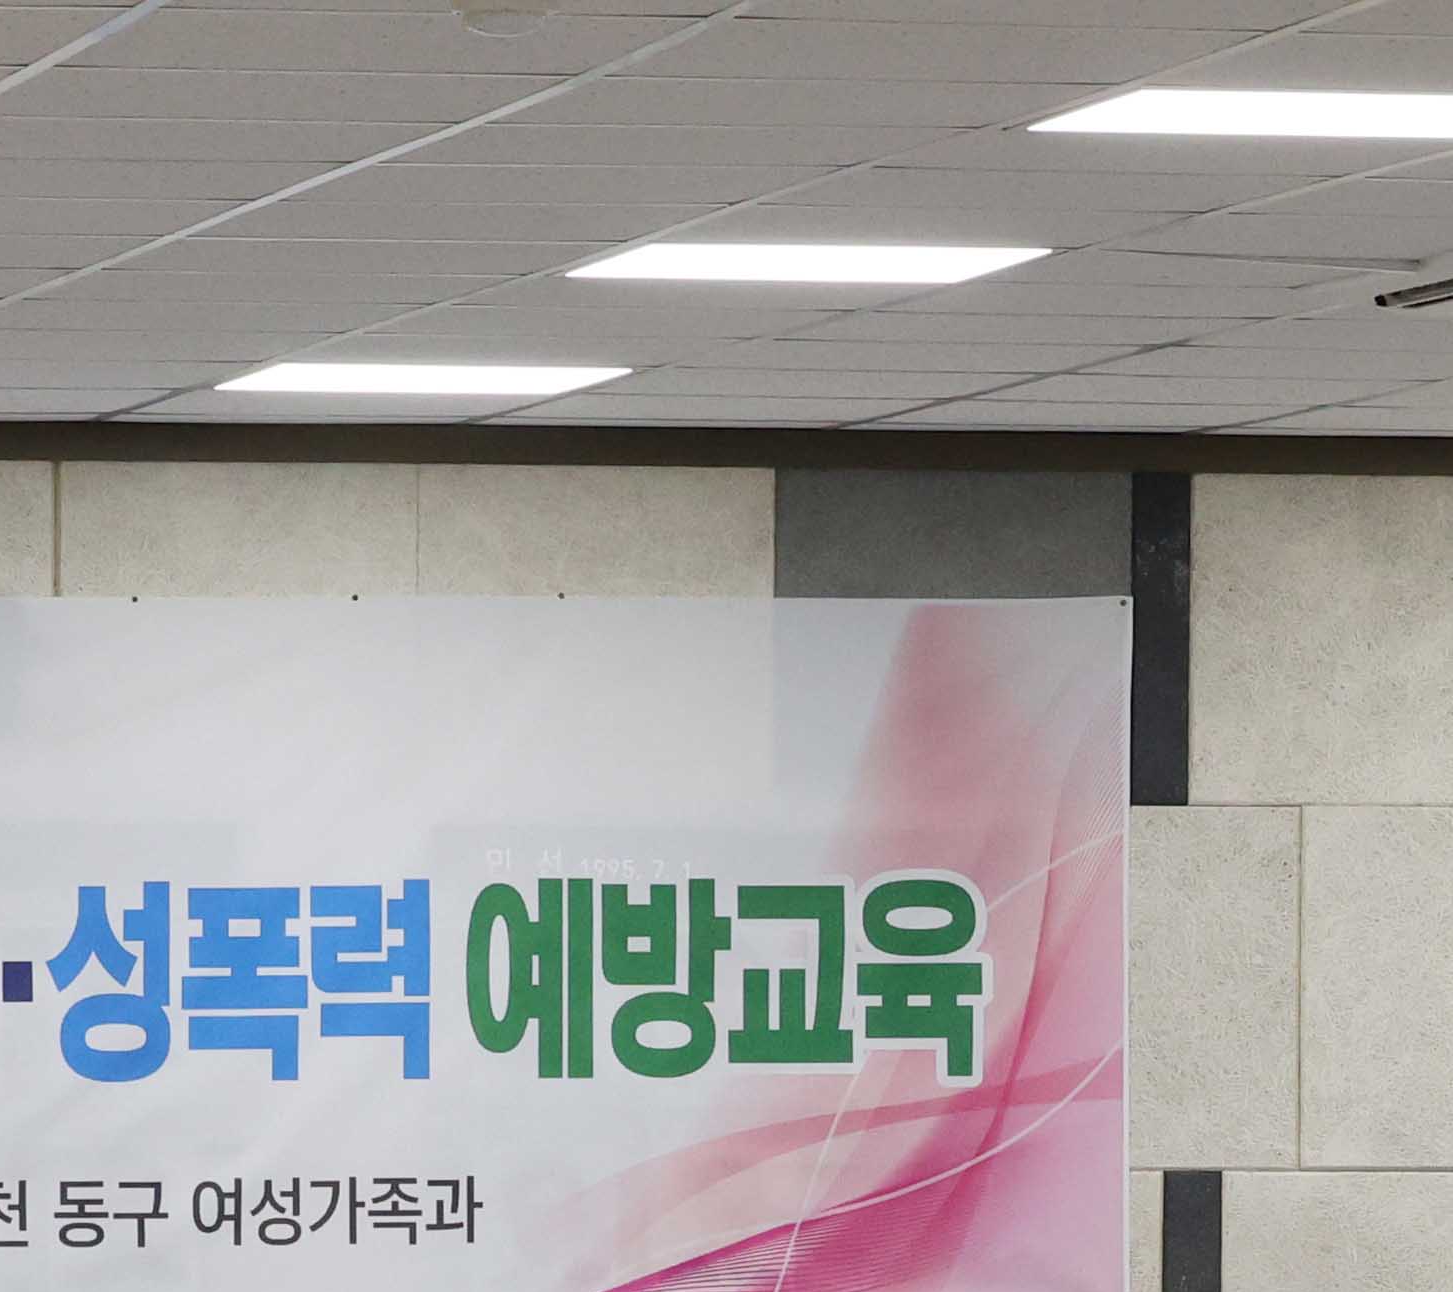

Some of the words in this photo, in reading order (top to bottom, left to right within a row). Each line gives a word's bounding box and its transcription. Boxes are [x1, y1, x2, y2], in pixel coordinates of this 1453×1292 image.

[466, 878, 983, 1080] 예방교육
[53, 1178, 169, 1248] 동구
[192, 1175, 484, 1248] 여성가족과
